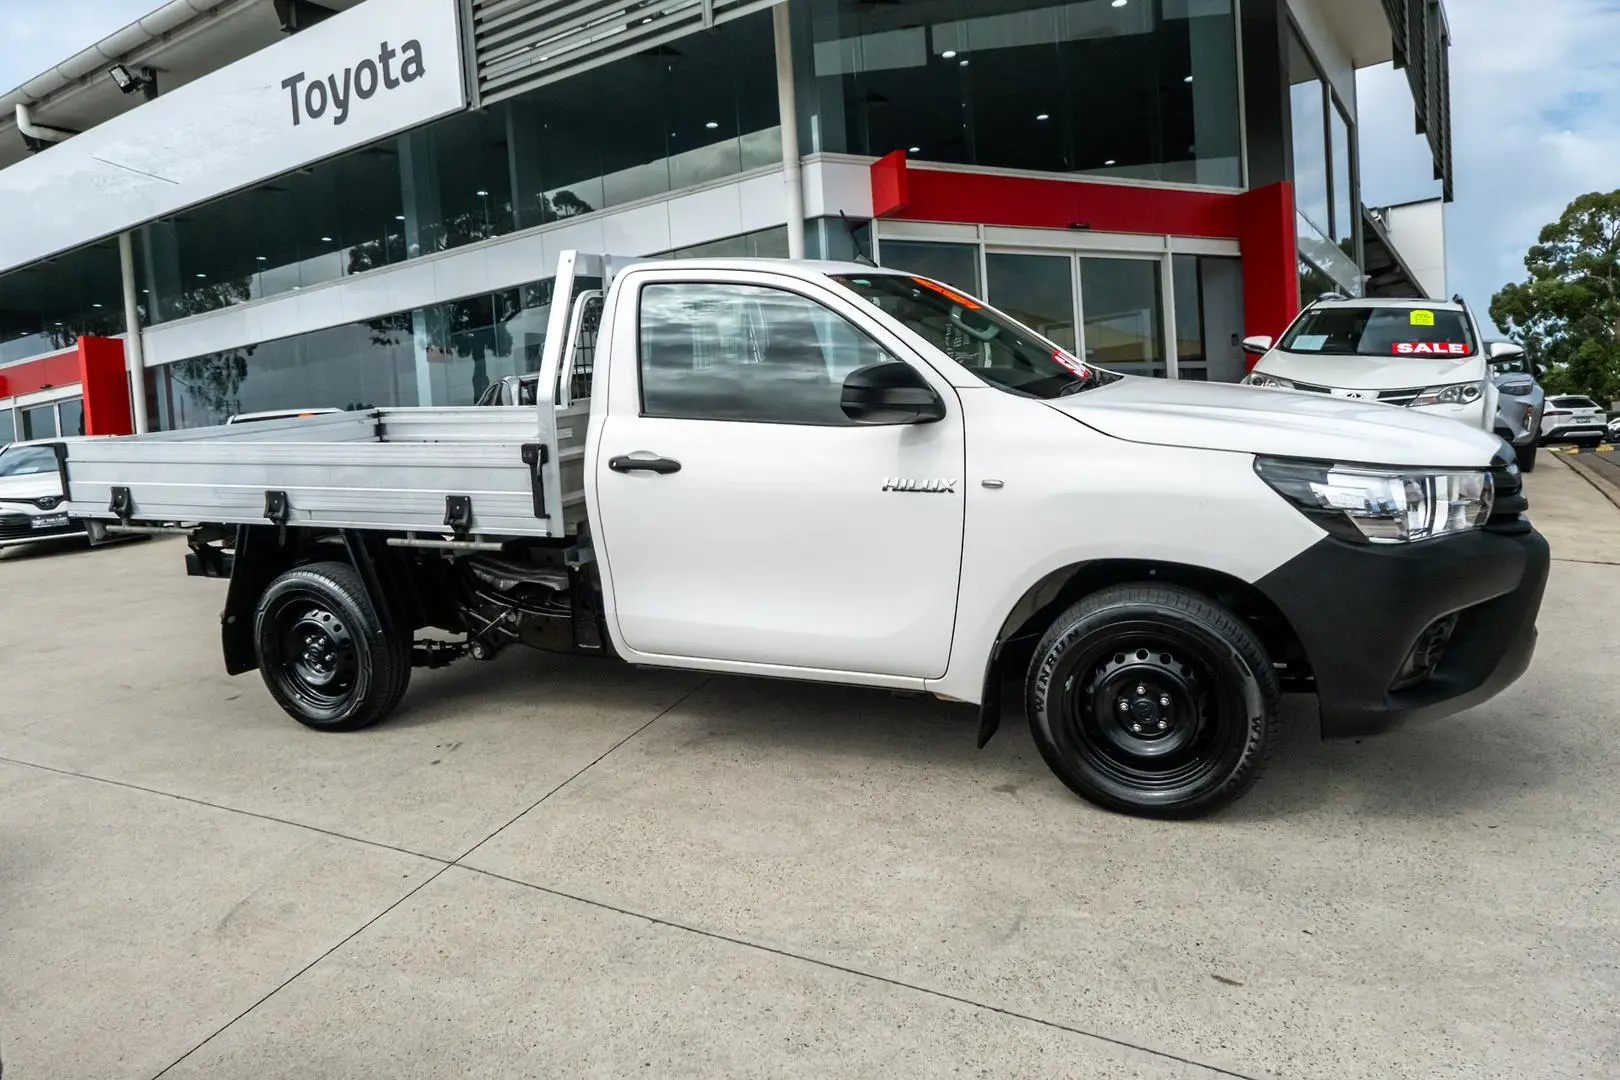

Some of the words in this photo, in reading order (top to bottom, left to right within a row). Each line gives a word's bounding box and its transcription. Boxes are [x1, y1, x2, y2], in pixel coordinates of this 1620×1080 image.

[281, 39, 426, 126] Toyota
[1397, 343, 1465, 354] SALE
[882, 477, 958, 493] HILUX
[1034, 628, 1079, 713] WINRUN
